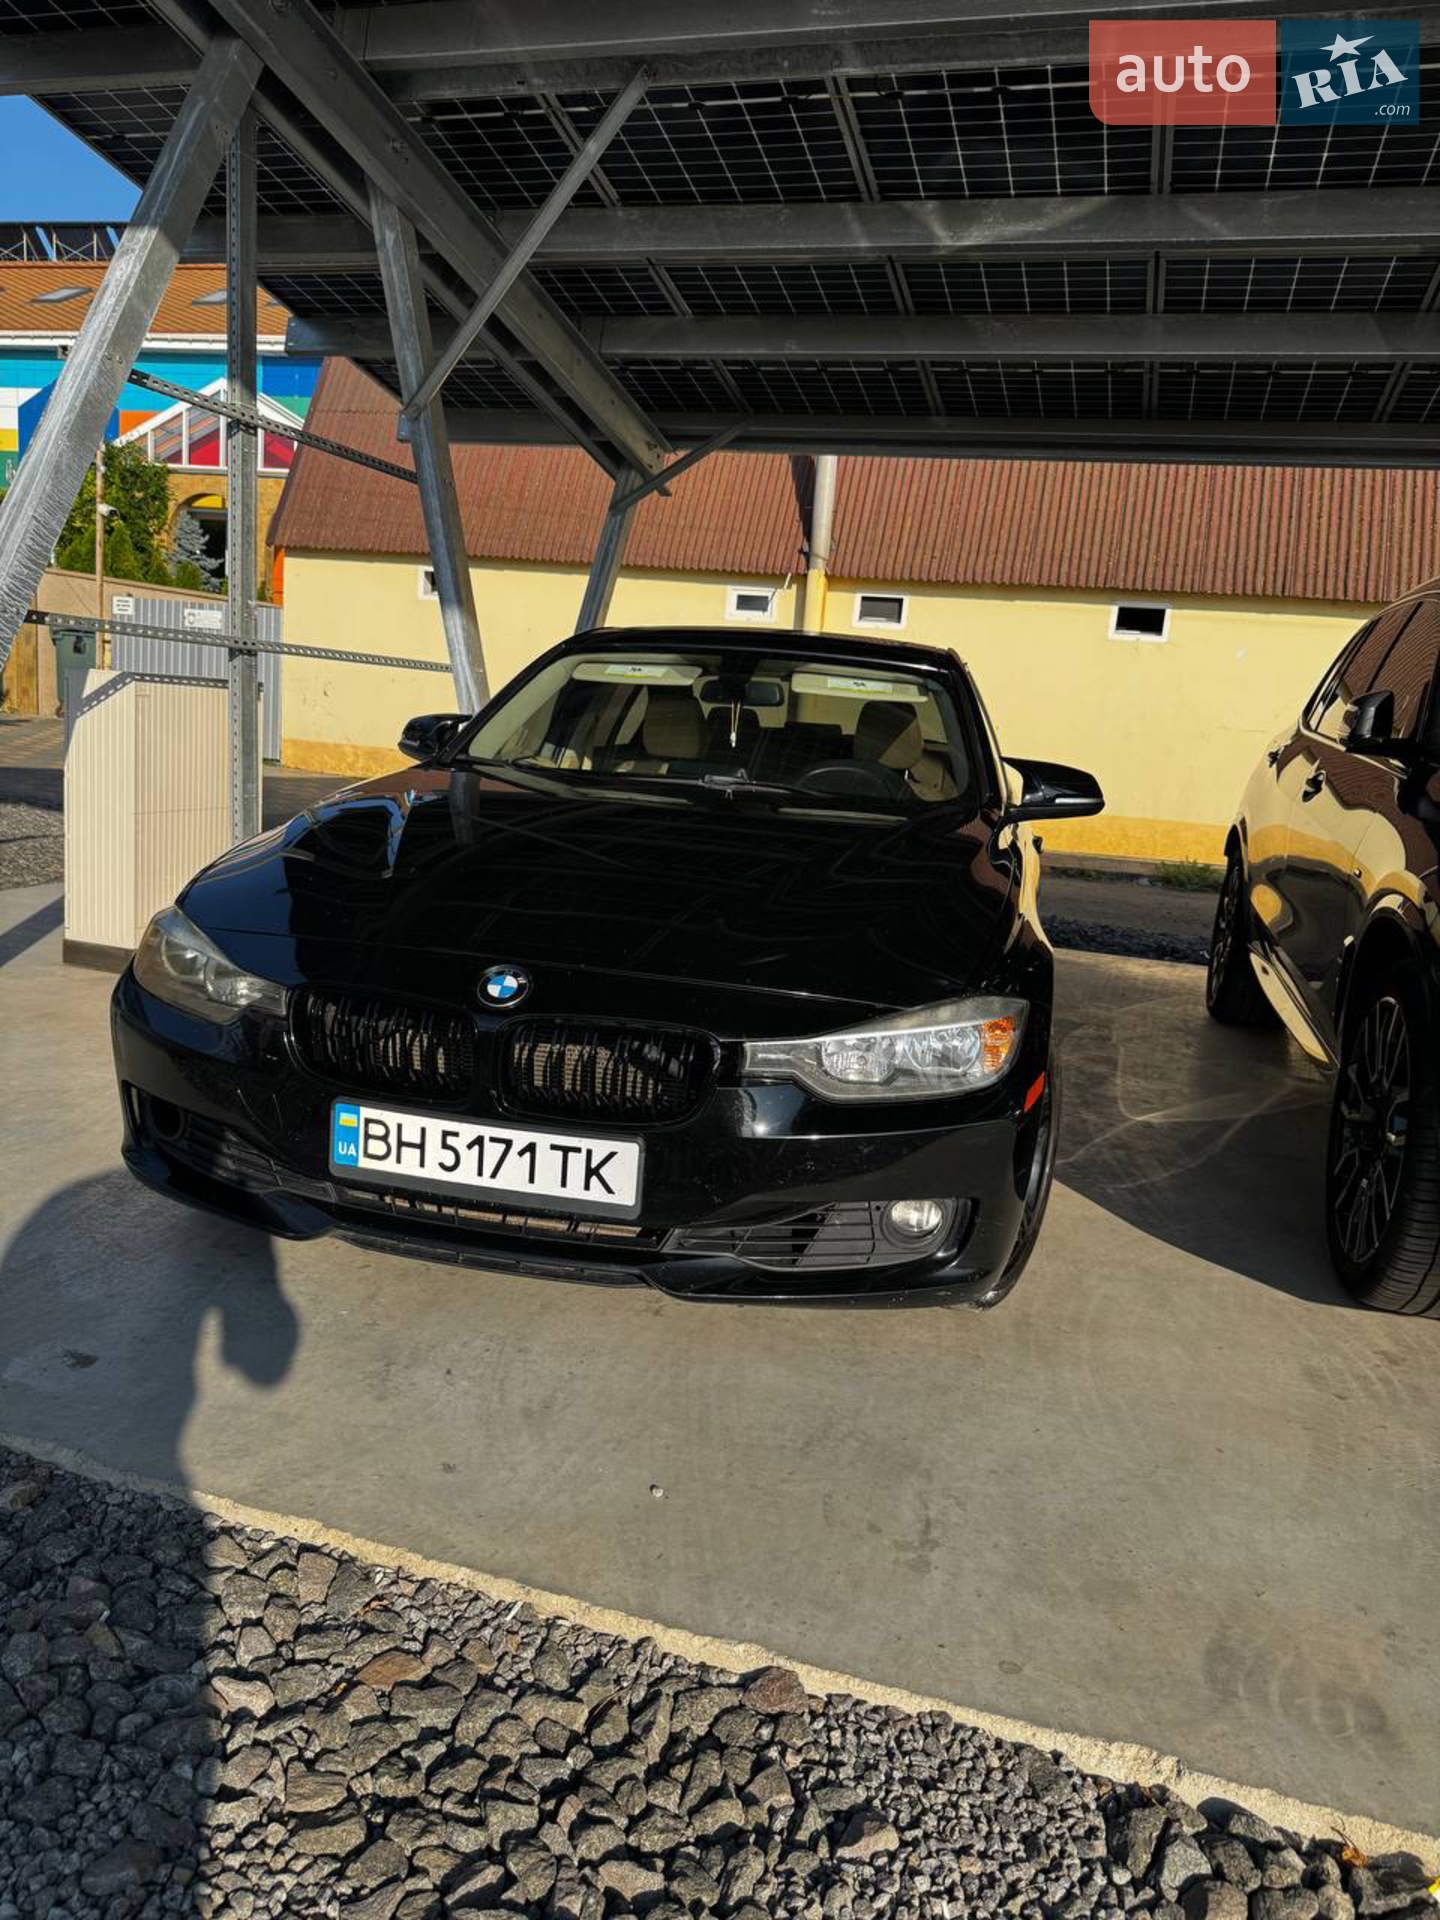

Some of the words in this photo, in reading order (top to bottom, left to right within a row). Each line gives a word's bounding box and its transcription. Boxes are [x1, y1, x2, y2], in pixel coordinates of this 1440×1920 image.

[338, 1140, 358, 1156] UA
[362, 1117, 427, 1168] BH
[437, 1129, 537, 1185] 5171
[549, 1143, 619, 1195] TK
